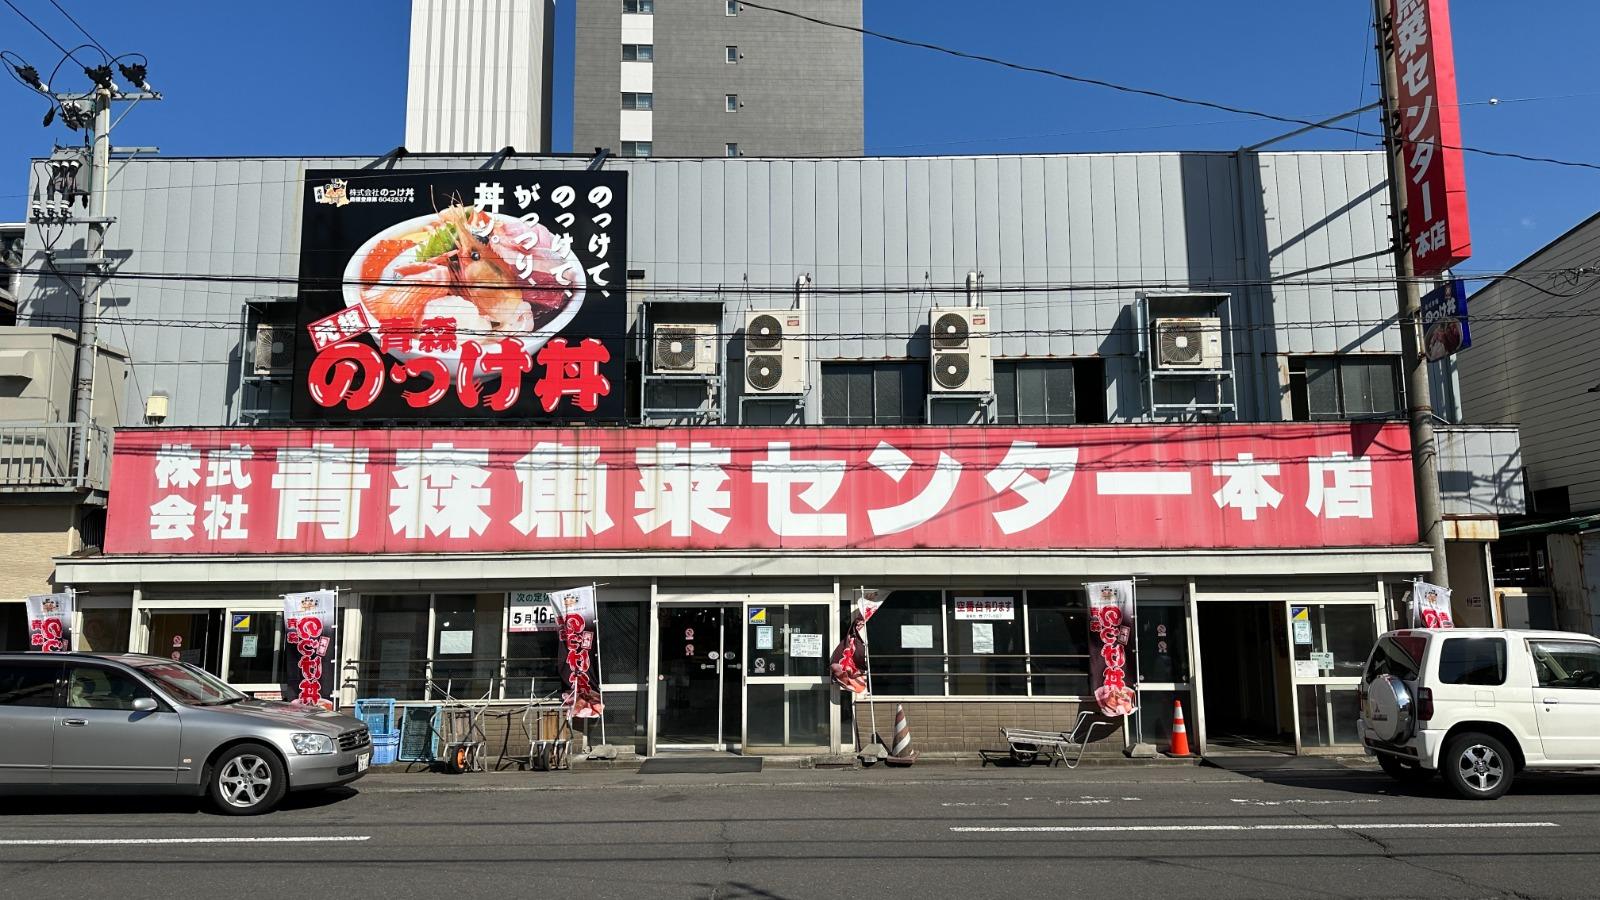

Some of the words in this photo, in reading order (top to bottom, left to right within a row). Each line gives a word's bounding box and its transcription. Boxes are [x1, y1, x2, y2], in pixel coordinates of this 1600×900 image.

[513, 183, 541, 287] がっつり、
[550, 185, 576, 298] のっけて、
[587, 185, 613, 298] のっけて、
[1415, 219, 1446, 258] 本店
[307, 337, 611, 413] のっけ丼
[378, 317, 458, 353] 青森
[154, 443, 253, 490] 株式
[149, 493, 249, 542] 会社
[297, 616, 324, 705] のっけ丼
[1098, 605, 1126, 690] のっけ丼
